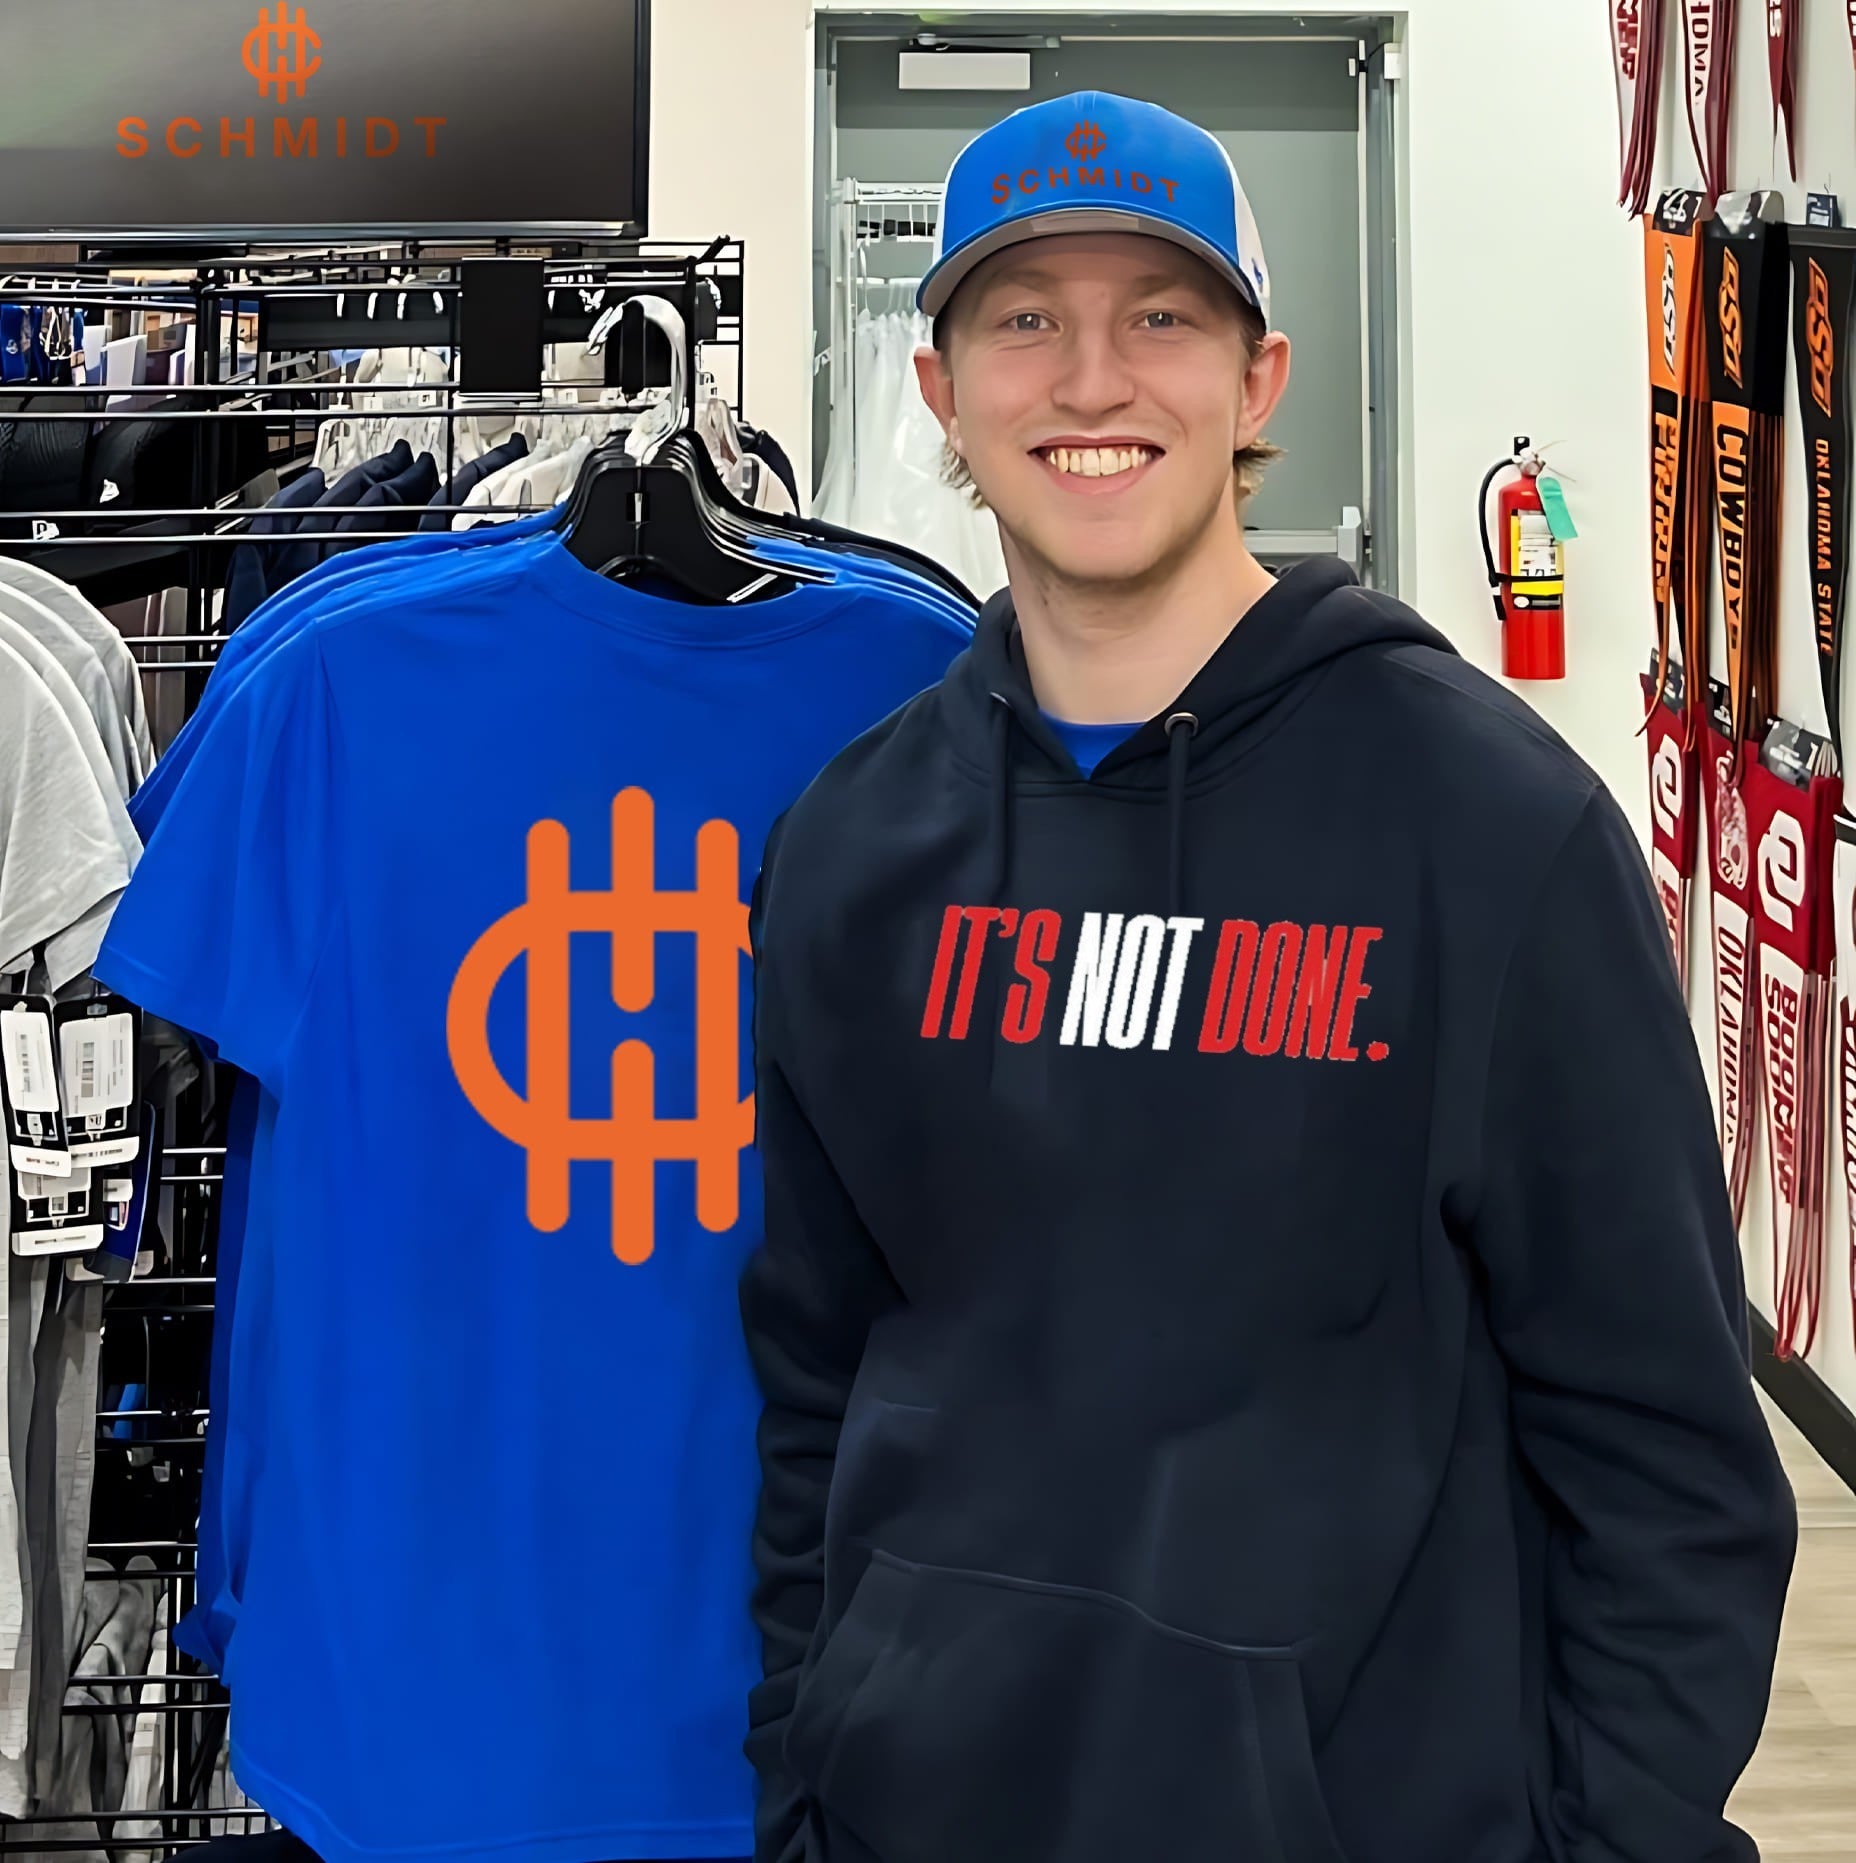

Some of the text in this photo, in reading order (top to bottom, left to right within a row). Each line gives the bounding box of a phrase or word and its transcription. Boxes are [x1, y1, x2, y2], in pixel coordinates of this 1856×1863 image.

[116, 116, 447, 158] SCHMIDT
[992, 167, 1179, 204] SCHMIDT
[1717, 423, 1748, 650] COWBOY
[1815, 438, 1832, 570] OKLAHOMA
[1758, 810, 1805, 932] OU
[920, 905, 1389, 1061] IT'S NOT DONE.
[1718, 926, 1745, 1144] OKLAHOMA
